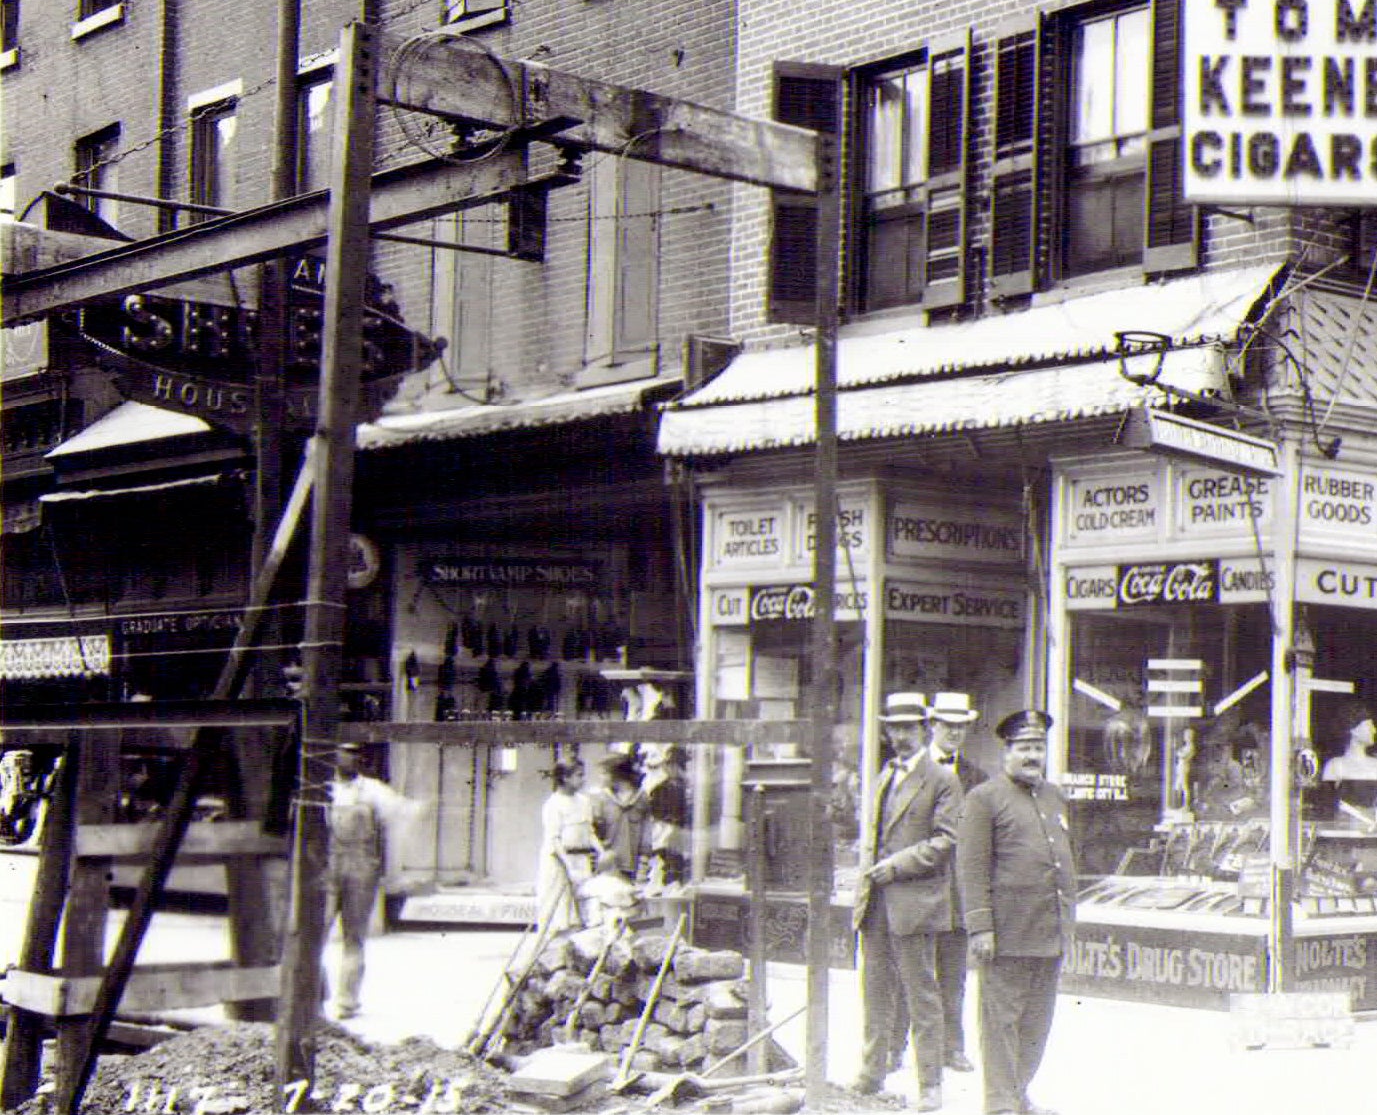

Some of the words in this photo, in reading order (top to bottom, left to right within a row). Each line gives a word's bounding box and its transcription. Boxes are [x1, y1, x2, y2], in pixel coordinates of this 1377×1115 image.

[153, 374, 256, 416] HOUS
[1083, 484, 1150, 508] ACTORS
[1189, 475, 1269, 500] GREASE
[1303, 474, 1375, 502] RUBBER
[807, 509, 863, 531] FSH
[1076, 512, 1109, 532] COLD
[1109, 507, 1155, 530] CREAM
[1191, 501, 1264, 524] PAINTS
[1307, 499, 1372, 525] GOODS
[729, 518, 777, 536] TOILET
[892, 517, 1021, 552] PRESCRIPTIONS
[724, 538, 779, 558] ARTICLES
[807, 531, 863, 552] DGS
[1067, 576, 1116, 599] CIGARS
[1121, 565, 1166, 604] Coca
[1164, 563, 1213, 601] Cola
[1221, 567, 1275, 592] CANDIES
[717, 594, 742, 616] CUT
[752, 589, 786, 621] Coca
[888, 588, 950, 614] EXPERT
[952, 592, 1019, 620] SERVICE
[1127, 941, 1183, 982] DRUG
[1188, 949, 1256, 991] STORE
[1295, 937, 1367, 977] NOLTE'S
